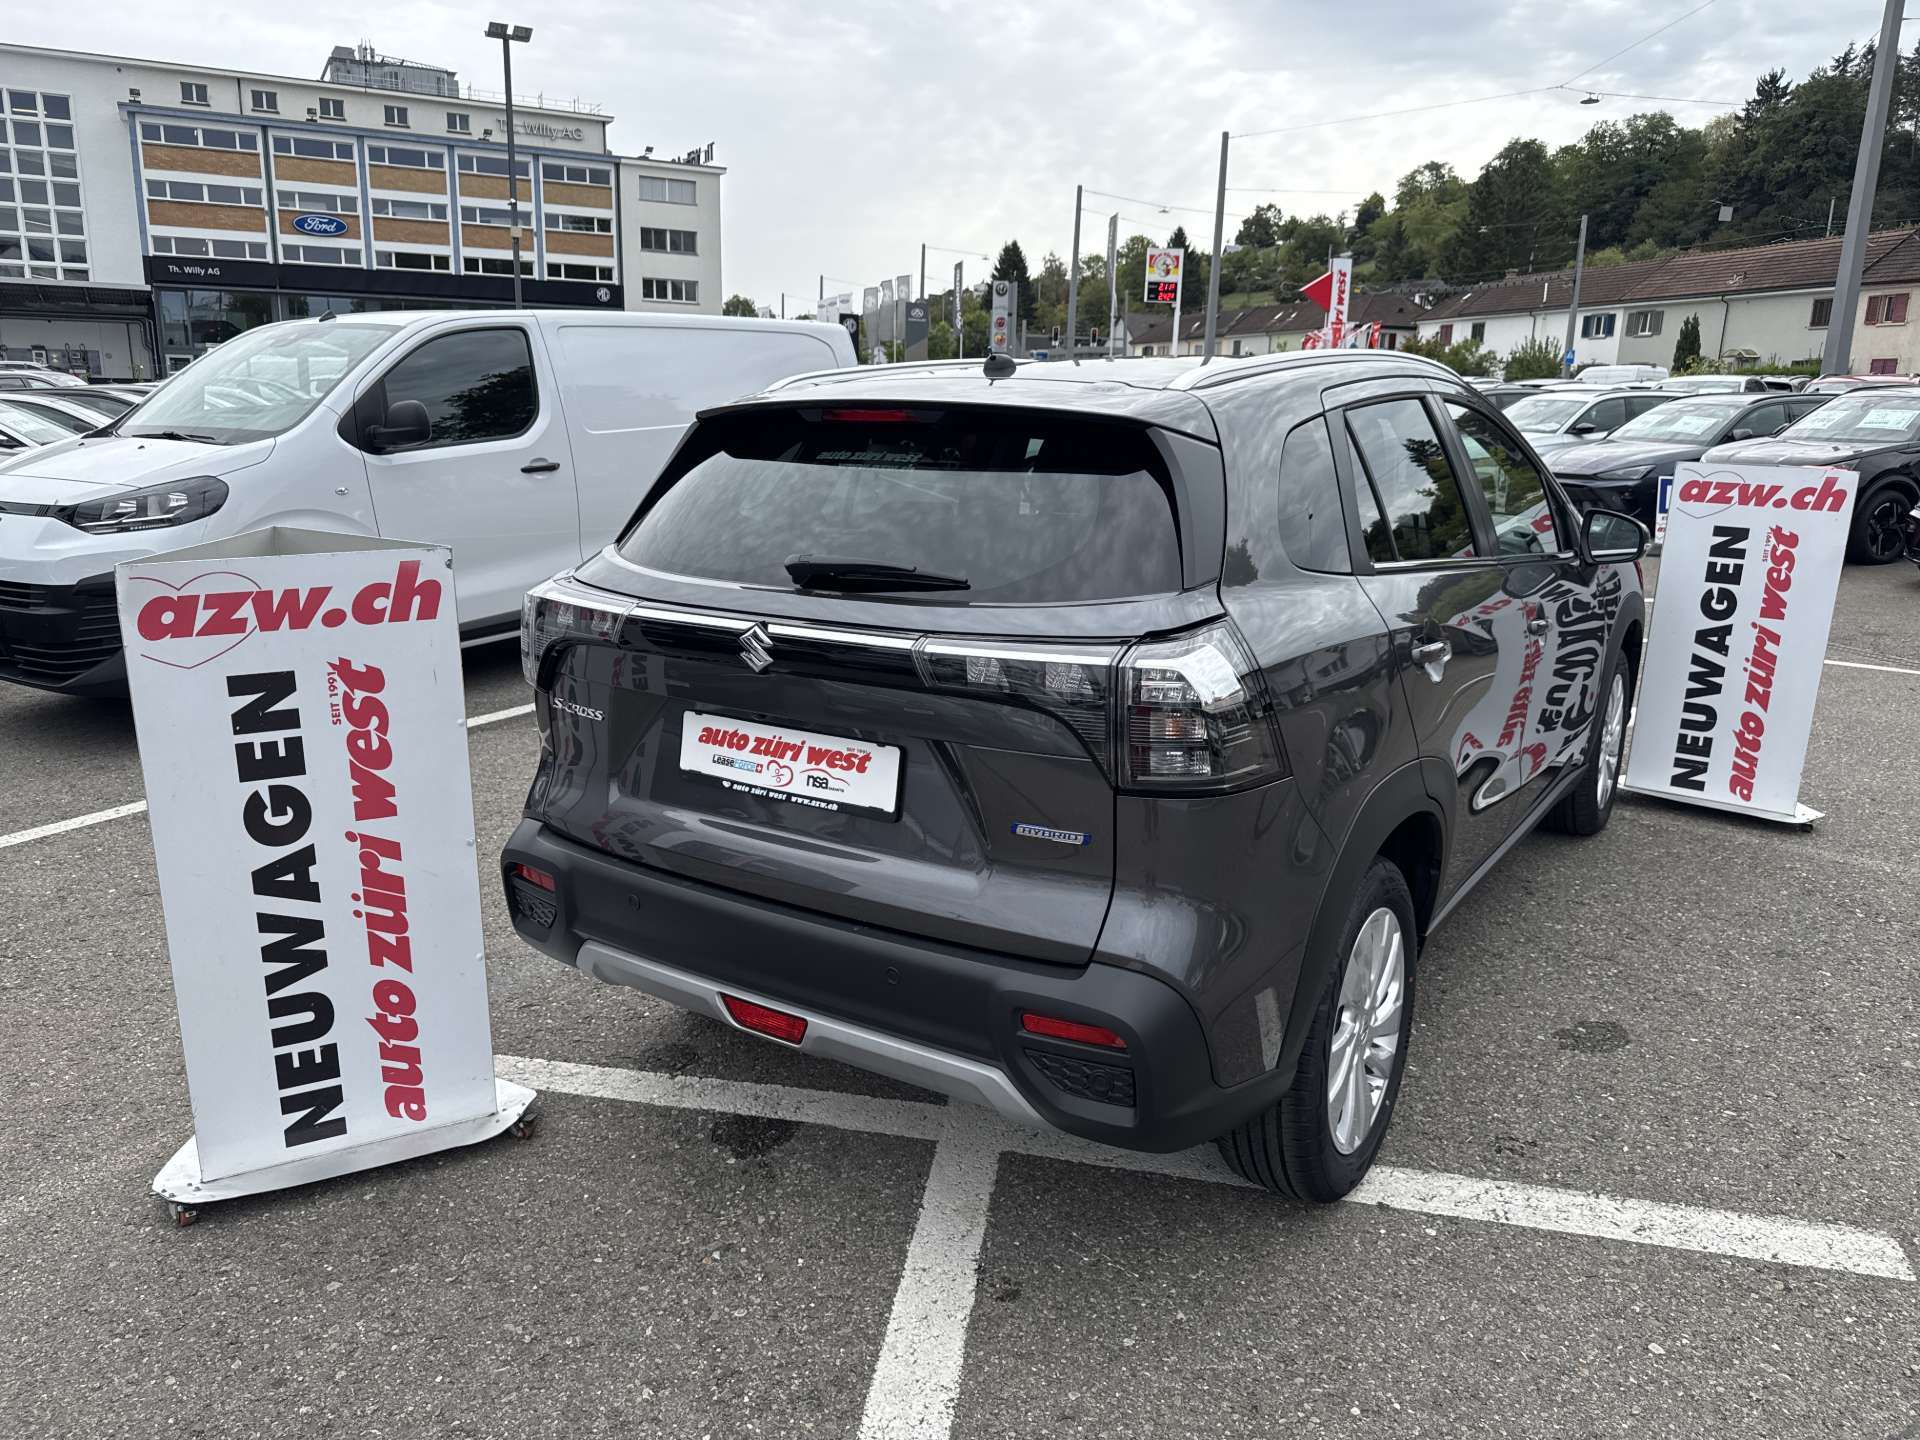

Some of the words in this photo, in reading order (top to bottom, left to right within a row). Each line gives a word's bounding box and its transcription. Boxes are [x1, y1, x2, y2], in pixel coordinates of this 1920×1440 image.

[524, 121, 557, 140] Willy
[561, 127, 584, 141] AG
[304, 217, 337, 232] Ford
[168, 265, 182, 273] Th.
[183, 266, 205, 277] Willy
[207, 267, 221, 276] AG
[1337, 269, 1348, 306] west
[1678, 476, 1848, 513] azw.ch
[1759, 525, 1799, 621] west
[137, 560, 443, 641] azw.ch
[1670, 524, 1750, 792] NEUWAGEN
[1743, 622, 1782, 713] züri
[327, 671, 339, 698] 1991
[330, 702, 342, 725] SEIT
[326, 656, 400, 822] west
[698, 726, 749, 751] auto
[751, 735, 806, 762] züri
[806, 746, 872, 774] west
[1729, 711, 1766, 802] auto
[732, 783, 750, 793] auto
[750, 786, 768, 797] züri
[768, 790, 787, 801] west
[790, 795, 839, 811] www.azw.ch
[806, 774, 829, 790] nsa
[226, 669, 348, 1149] NEUWAGEN
[345, 830, 418, 974] züri
[364, 978, 428, 1122] auto
